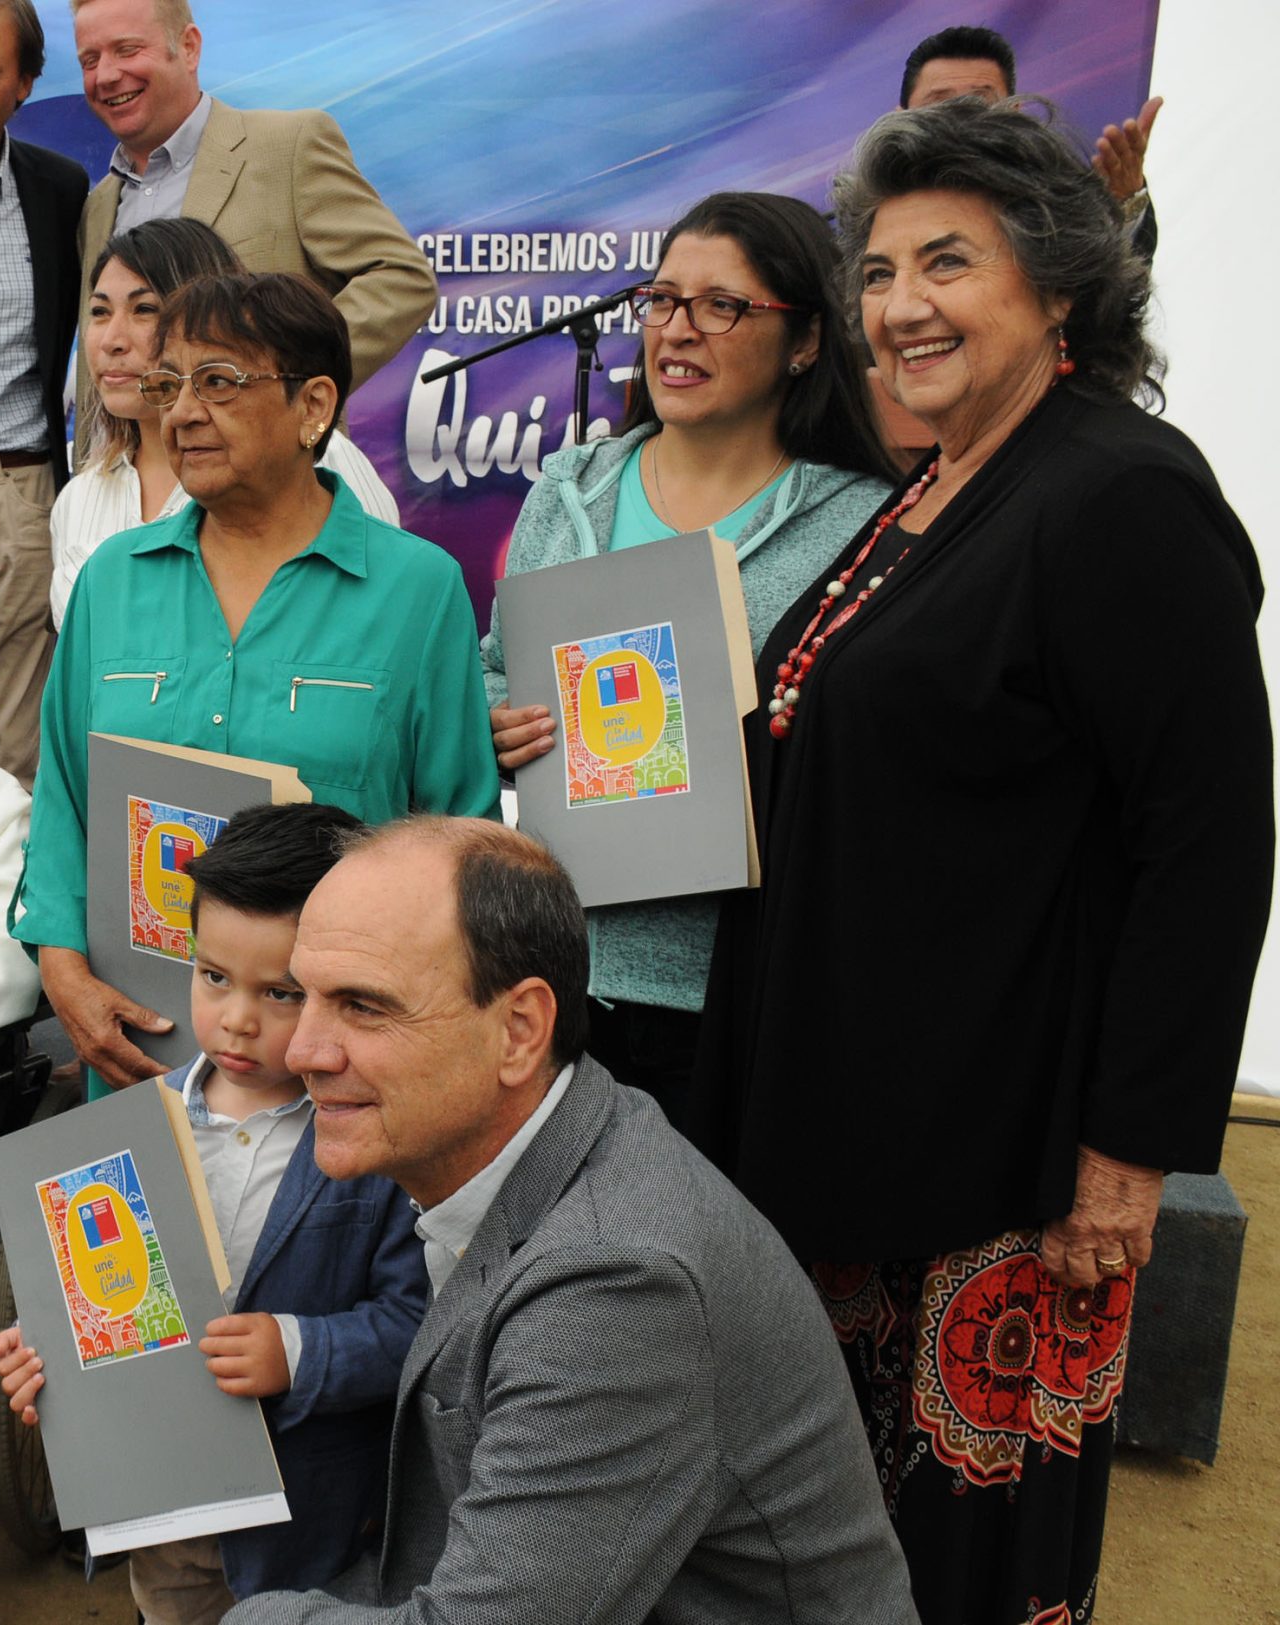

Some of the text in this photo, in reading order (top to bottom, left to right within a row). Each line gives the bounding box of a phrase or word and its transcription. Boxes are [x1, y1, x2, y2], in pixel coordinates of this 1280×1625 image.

[417, 231, 669, 273] CELEBREMOS JU
[417, 295, 448, 334] U
[456, 295, 533, 334] CASA
[603, 716, 625, 728] une
[606, 723, 643, 747] Ciudad
[161, 880, 180, 893] une
[163, 892, 192, 910] Ciuda
[94, 1259, 114, 1274] une
[101, 1267, 135, 1296] Ciudad
